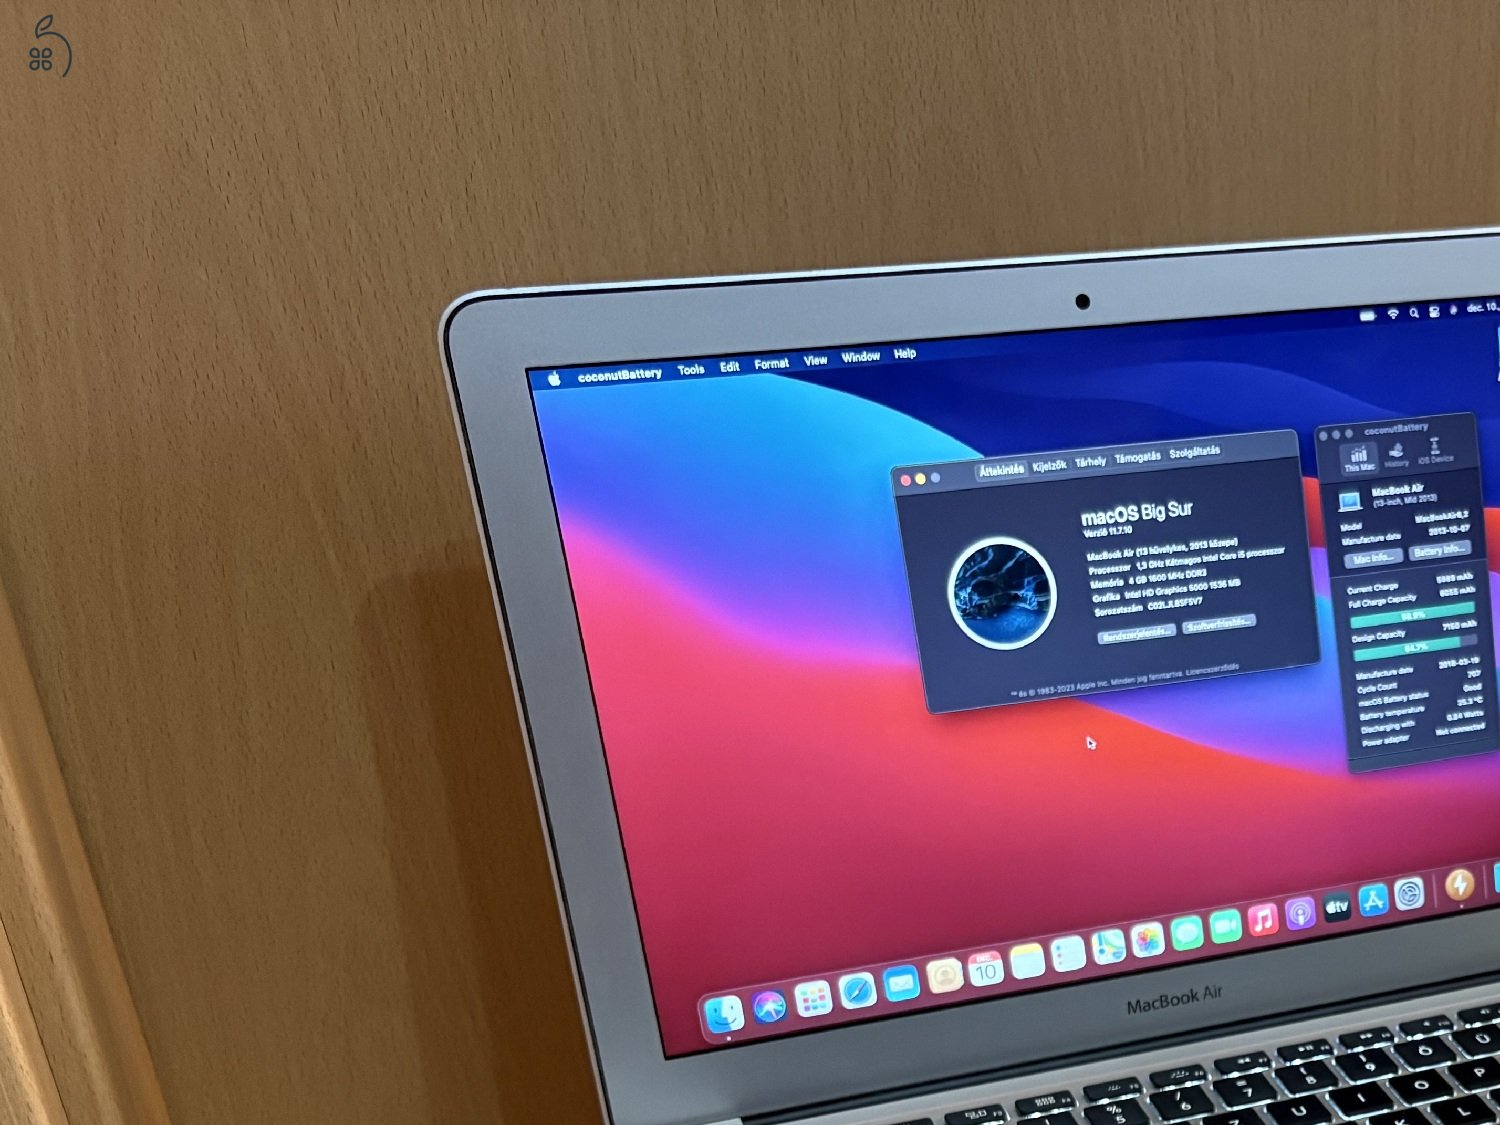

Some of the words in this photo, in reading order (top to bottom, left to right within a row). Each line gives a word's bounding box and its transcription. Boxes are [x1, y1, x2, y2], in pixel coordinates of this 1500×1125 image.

[578, 366, 662, 384] coconutBattery
[677, 364, 705, 376] Tools
[720, 361, 740, 373] Edit
[755, 358, 789, 371] Format
[804, 354, 828, 366] View
[841, 350, 880, 364] Window
[894, 347, 917, 361] Help
[1364, 423, 1429, 436] coconutBattery
[1075, 457, 1106, 468] Tárhely
[1115, 451, 1161, 464] Támogatás
[1344, 464, 1359, 472] This
[1361, 462, 1376, 471] Mac
[1372, 485, 1411, 497] MacBook
[1412, 483, 1424, 492] Air
[1081, 505, 1139, 526] macOS
[1141, 504, 1166, 522] Big
[1168, 501, 1193, 517] Sur
[1087, 549, 1122, 561] MacBook
[1123, 548, 1134, 557] Air
[1089, 564, 1131, 575] Processzor
[976, 964, 996, 981] 10
[1128, 988, 1199, 1015] MacBook
[1203, 985, 1222, 1000] Air
